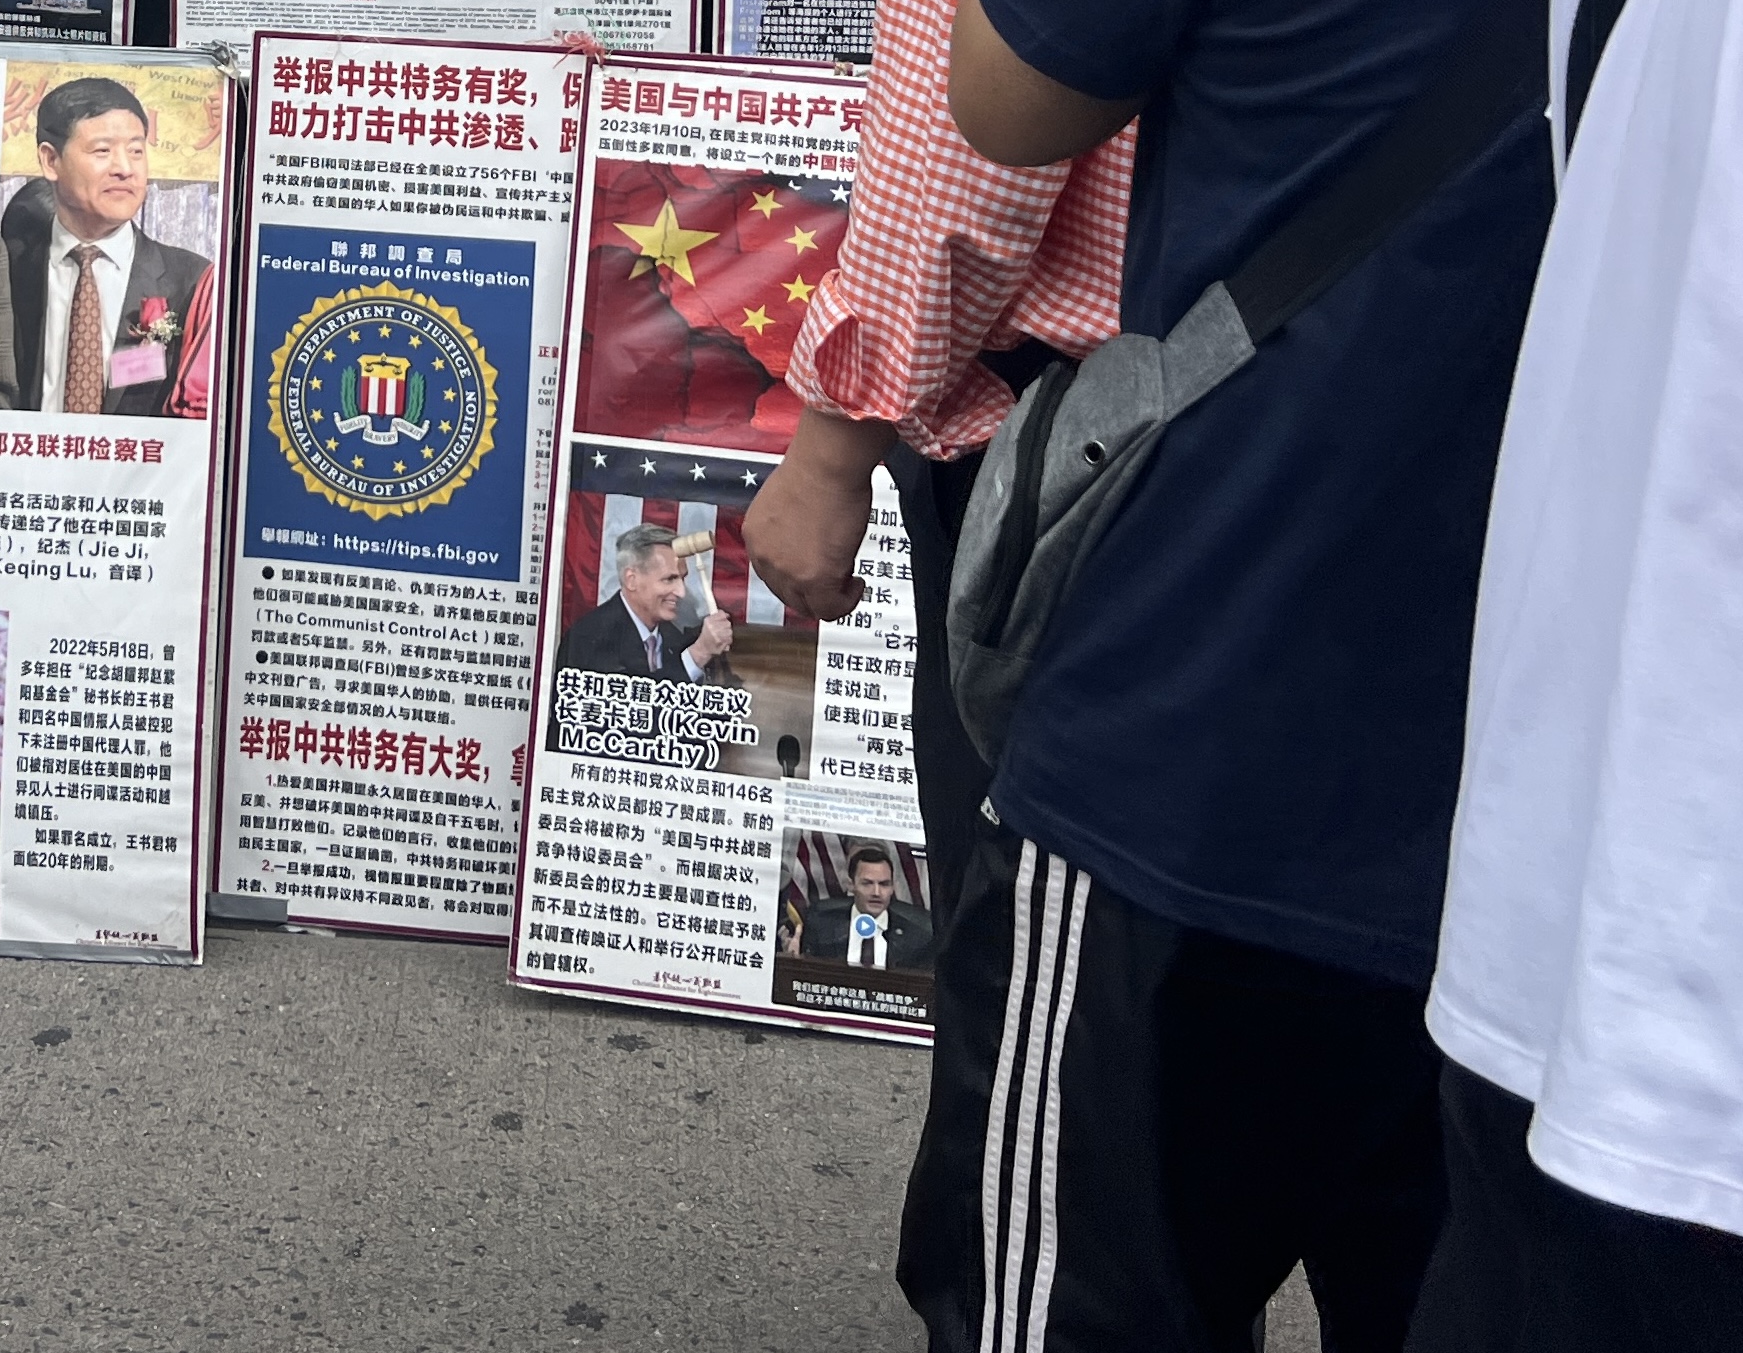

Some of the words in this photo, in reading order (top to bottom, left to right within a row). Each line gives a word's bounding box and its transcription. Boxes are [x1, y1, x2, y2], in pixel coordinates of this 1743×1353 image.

[600, 76, 864, 133] 美国与中国共产党
[260, 254, 325, 274] Federal
[329, 259, 391, 278] Bureau
[394, 265, 412, 278] of
[415, 265, 530, 287] Investigation
[297, 305, 395, 365] DEPARTMENT
[400, 310, 421, 324] OF
[423, 319, 472, 379] JUSTICE
[289, 375, 313, 453] FEDERAL
[310, 452, 368, 494] BUREAU
[373, 483, 395, 496] OF
[400, 389, 477, 496] INVESTIGATION
[297, 612, 385, 634] Communist
[388, 622, 447, 639] Control
[450, 628, 477, 643] Act
[558, 670, 752, 716] 共和党籍众议院议
[571, 762, 773, 804] 所有的共和党众议员和146名
[529, 922, 764, 969] 其调查传唤证人和举行公开听证会
